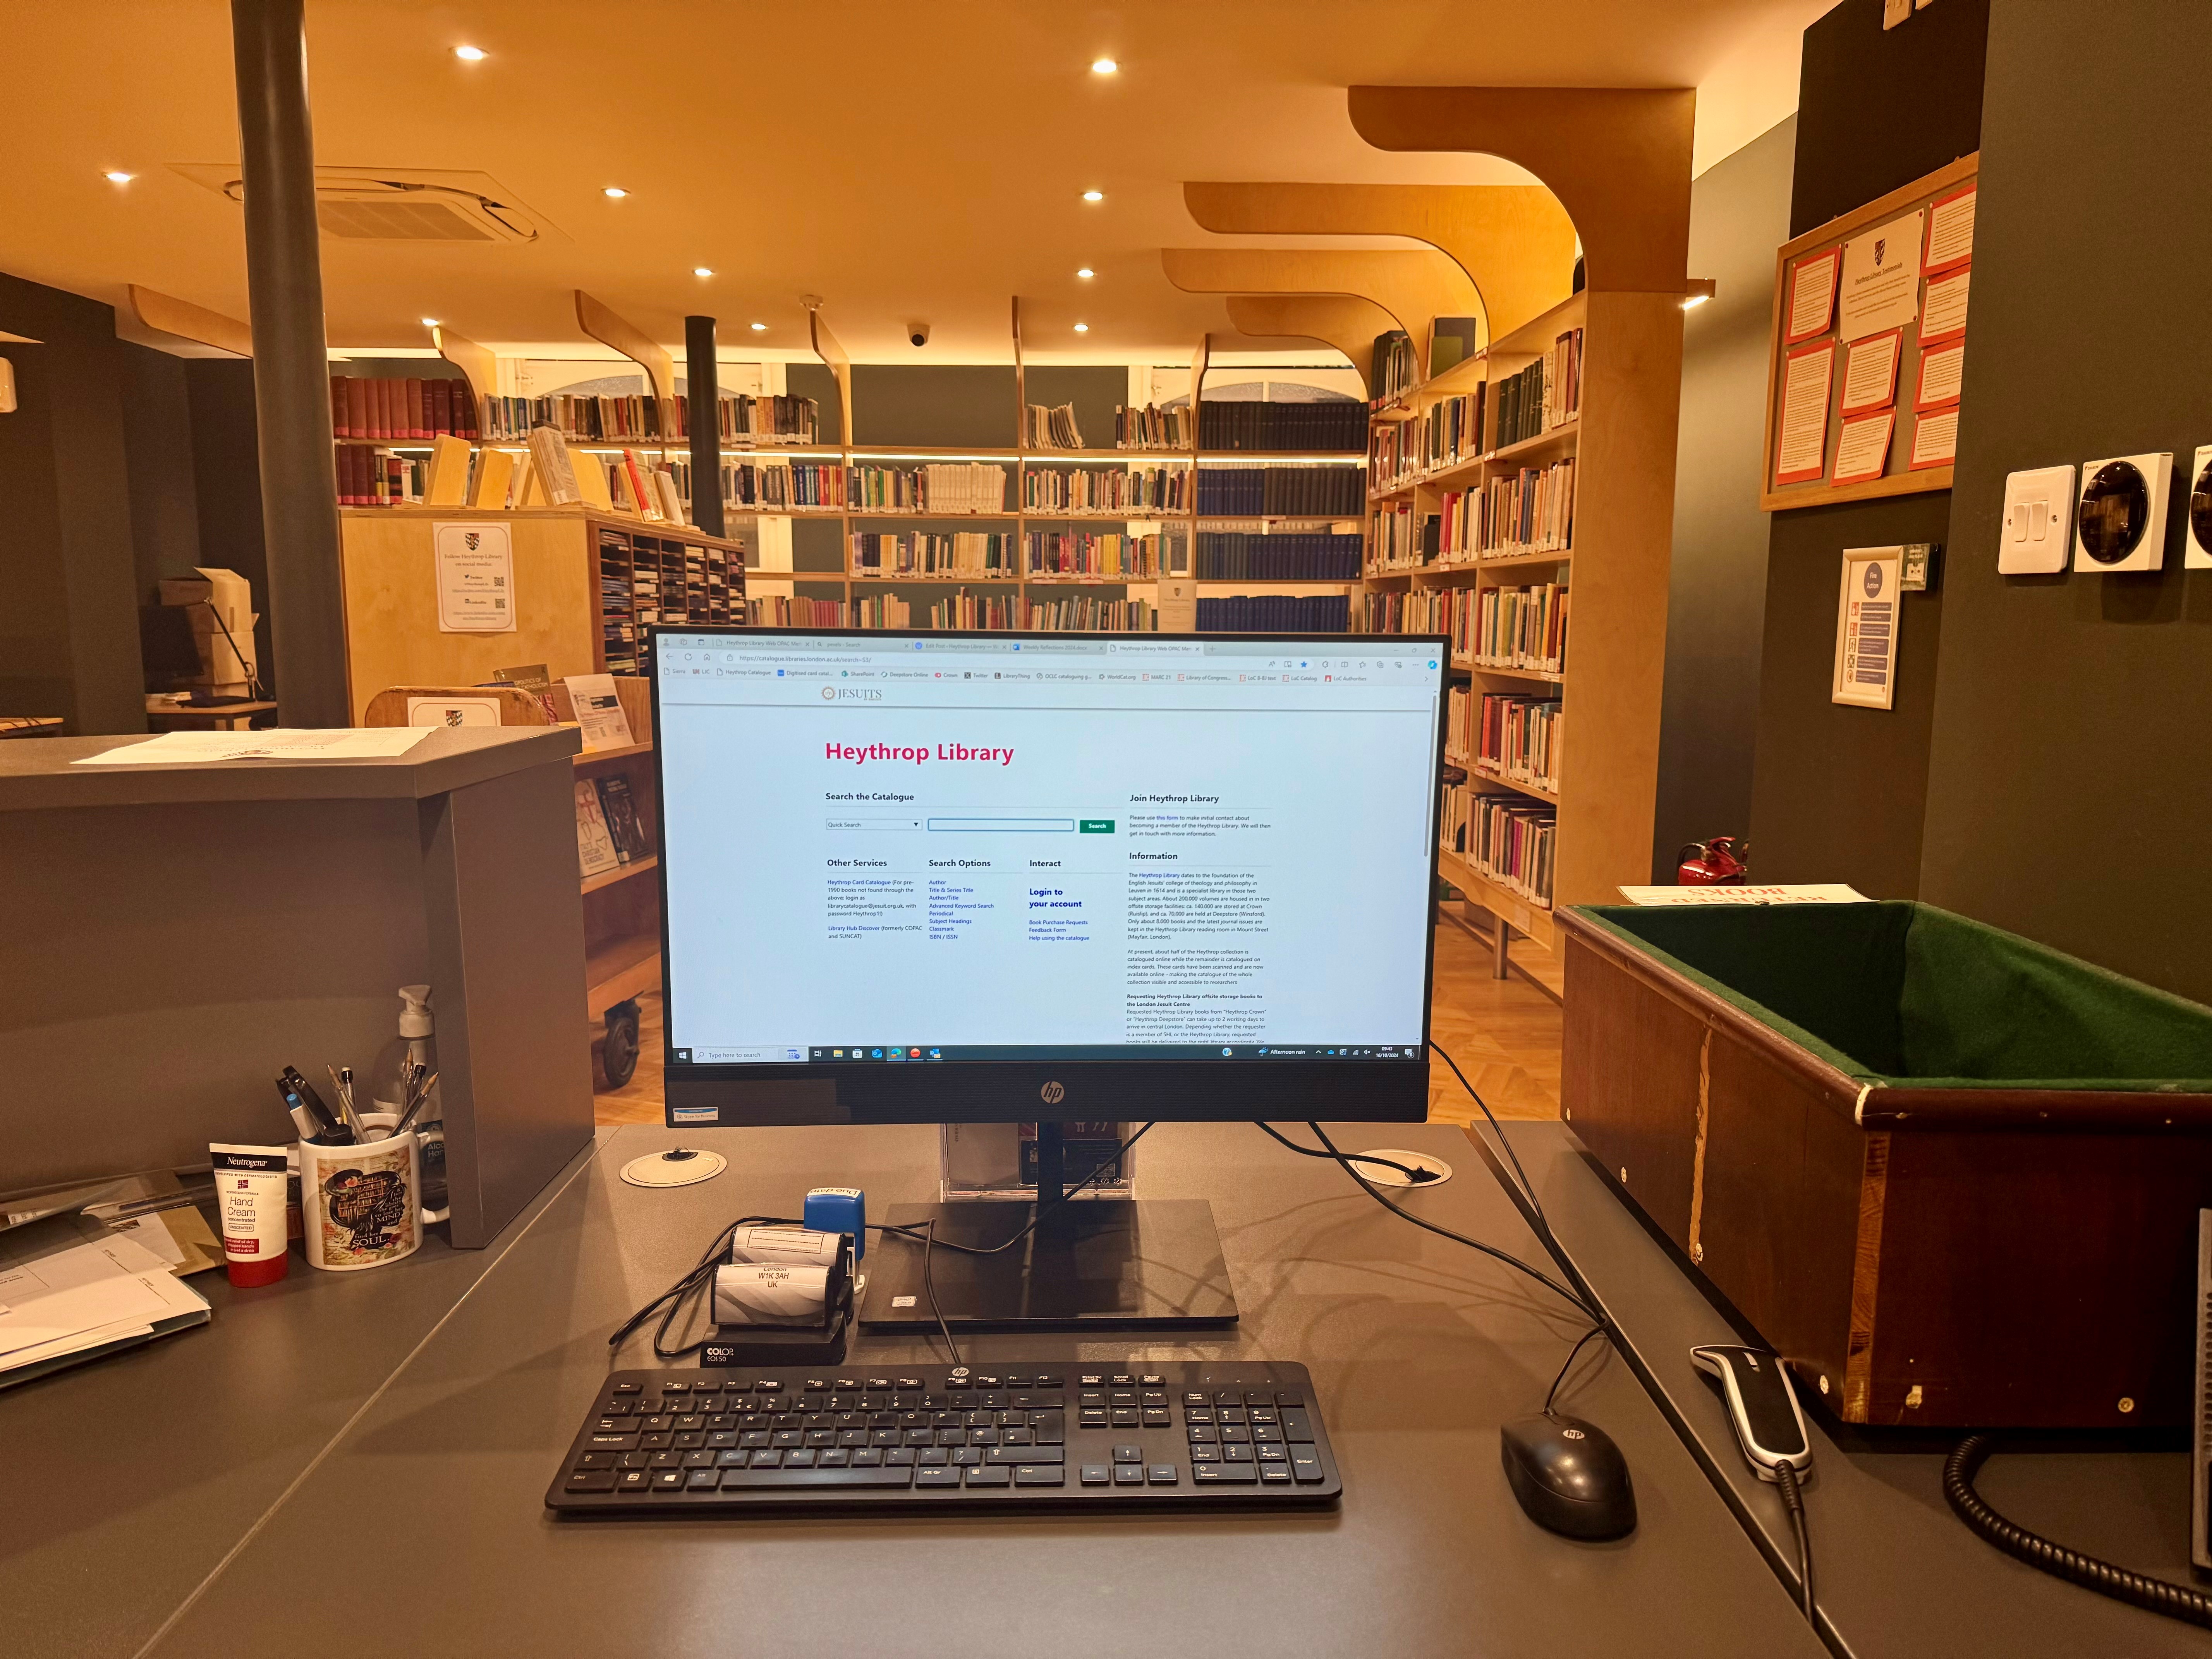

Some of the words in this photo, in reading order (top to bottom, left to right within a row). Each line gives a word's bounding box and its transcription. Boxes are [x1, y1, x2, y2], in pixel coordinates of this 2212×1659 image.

[838, 689, 882, 699] JESUITS
[826, 743, 929, 764] Heythrop
[938, 744, 1013, 765] Library
[872, 793, 914, 802] Catalogue
[1149, 794, 1188, 804] Heythrop
[1190, 794, 1219, 804] Library
[1129, 852, 1178, 860] Information
[958, 859, 991, 869] Options
[1029, 888, 1052, 897] Login
[1044, 1081, 1062, 1104] hp
[227, 1156, 266, 1168] Neutrogena
[230, 1196, 253, 1207] Hand
[227, 1207, 256, 1217] Cream
[353, 1235, 390, 1247] SOUL.
